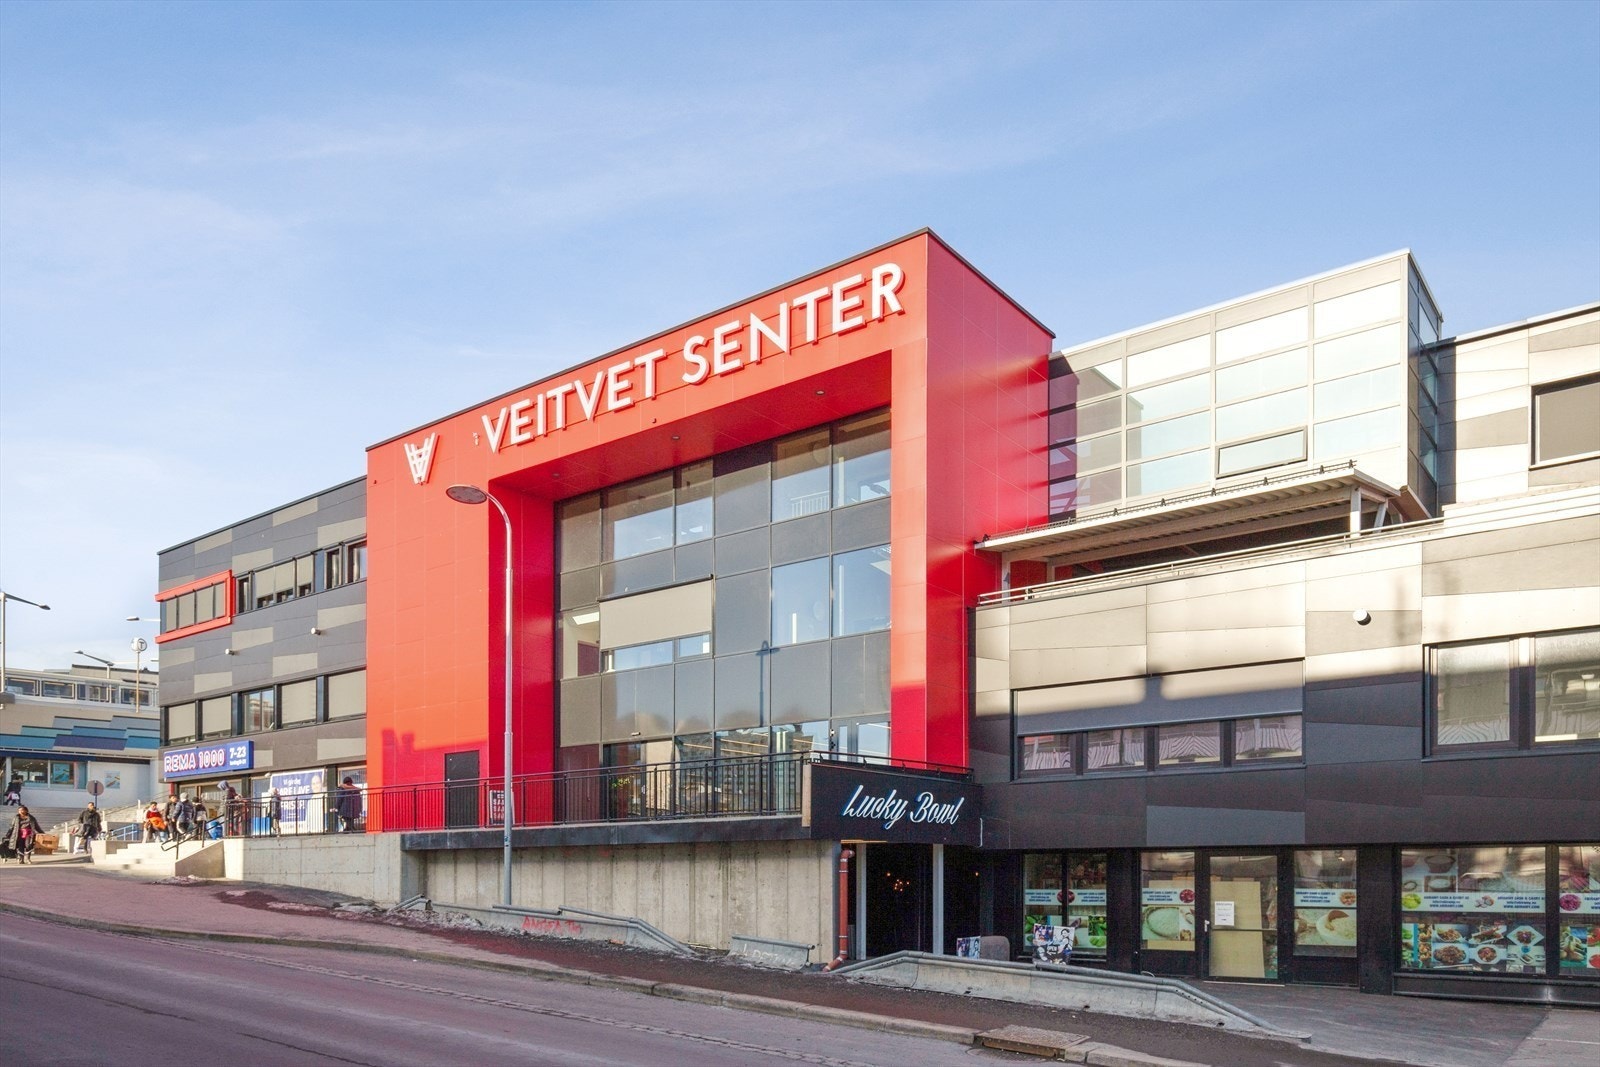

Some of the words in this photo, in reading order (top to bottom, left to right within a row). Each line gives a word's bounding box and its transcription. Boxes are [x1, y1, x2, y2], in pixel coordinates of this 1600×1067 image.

[481, 348, 667, 454] VEITVET
[681, 262, 906, 386] SENTER
[164, 753, 197, 773] REMA
[198, 748, 226, 769] 1000
[229, 745, 247, 760] 7-23
[841, 784, 909, 831] Lucky
[909, 791, 965, 825] Bowl
